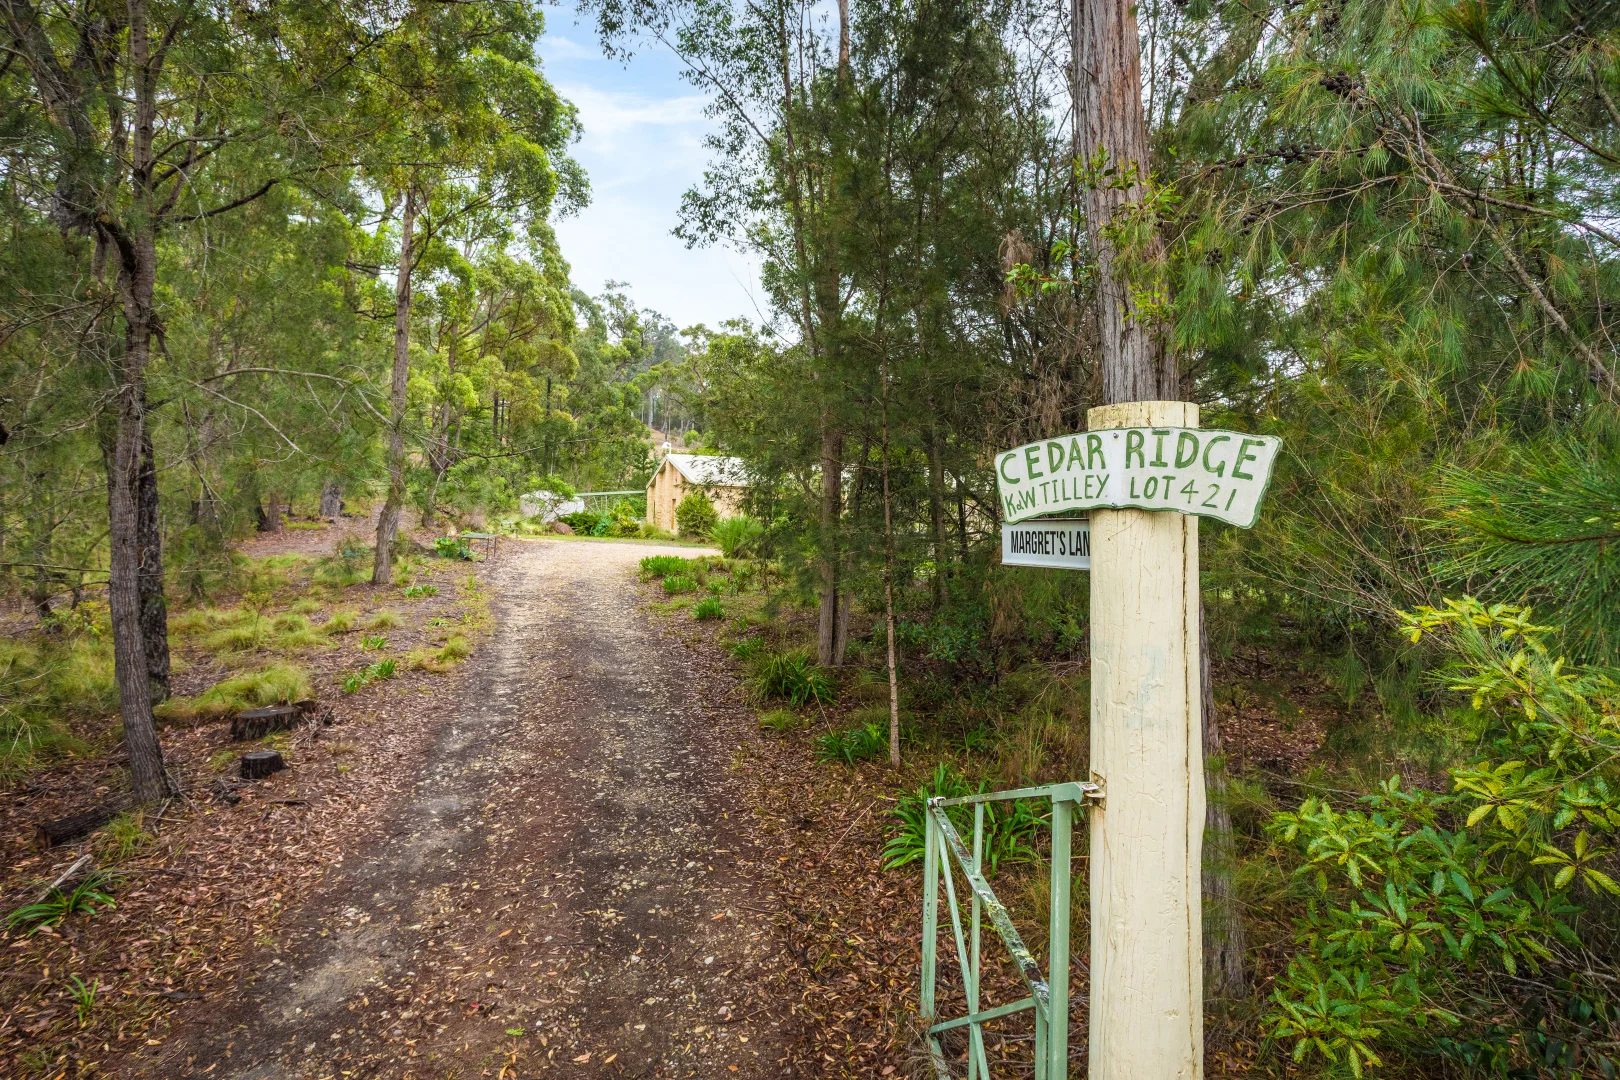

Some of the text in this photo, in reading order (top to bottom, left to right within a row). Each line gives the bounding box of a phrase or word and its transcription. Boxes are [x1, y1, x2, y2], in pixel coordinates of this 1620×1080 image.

[1000, 430, 1266, 484] CEDAR RIDGE
[1039, 473, 1110, 504] TILLEY
[1130, 475, 1176, 500] LOT
[1180, 479, 1237, 511] 421
[1011, 530, 1066, 555] MARGRET'S
